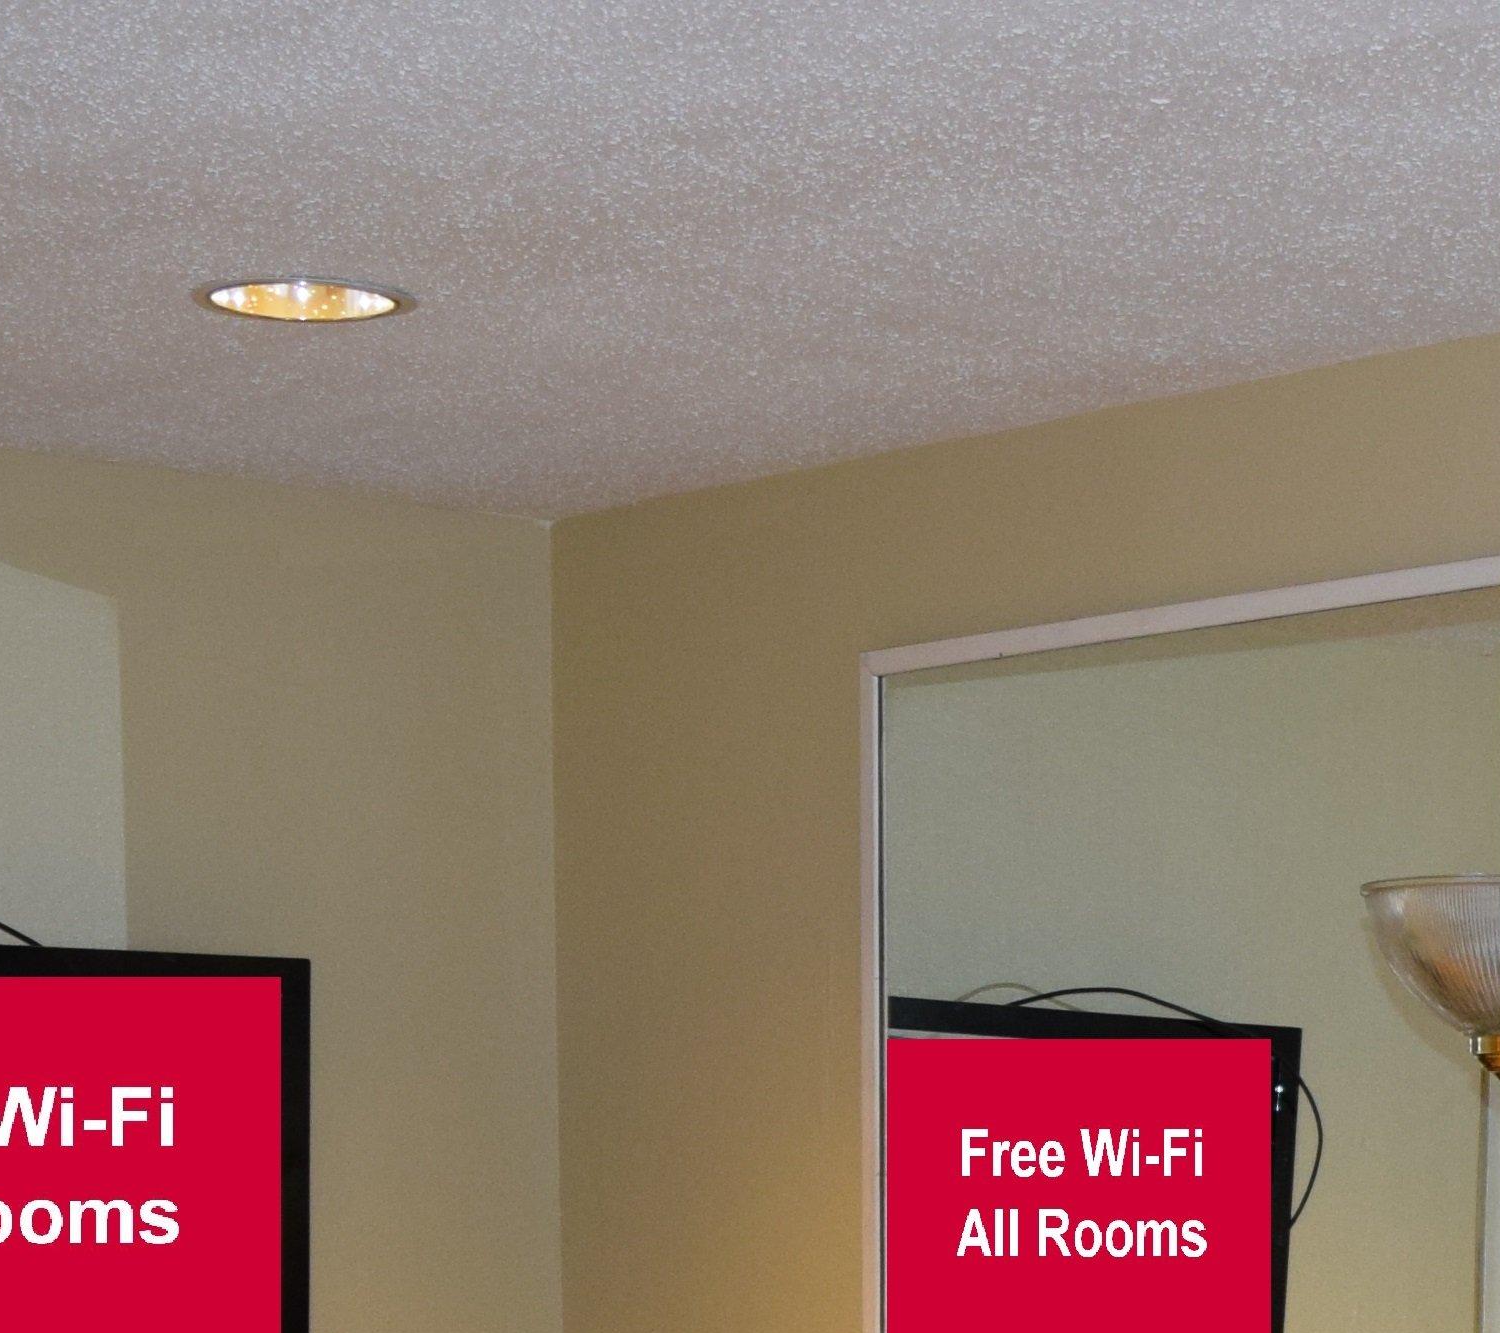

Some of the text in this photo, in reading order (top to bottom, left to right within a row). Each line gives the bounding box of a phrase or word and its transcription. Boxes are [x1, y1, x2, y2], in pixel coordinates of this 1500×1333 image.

[960, 1129, 1203, 1178] Free Wi-Fi
[957, 1209, 1208, 1258] All Rooms
